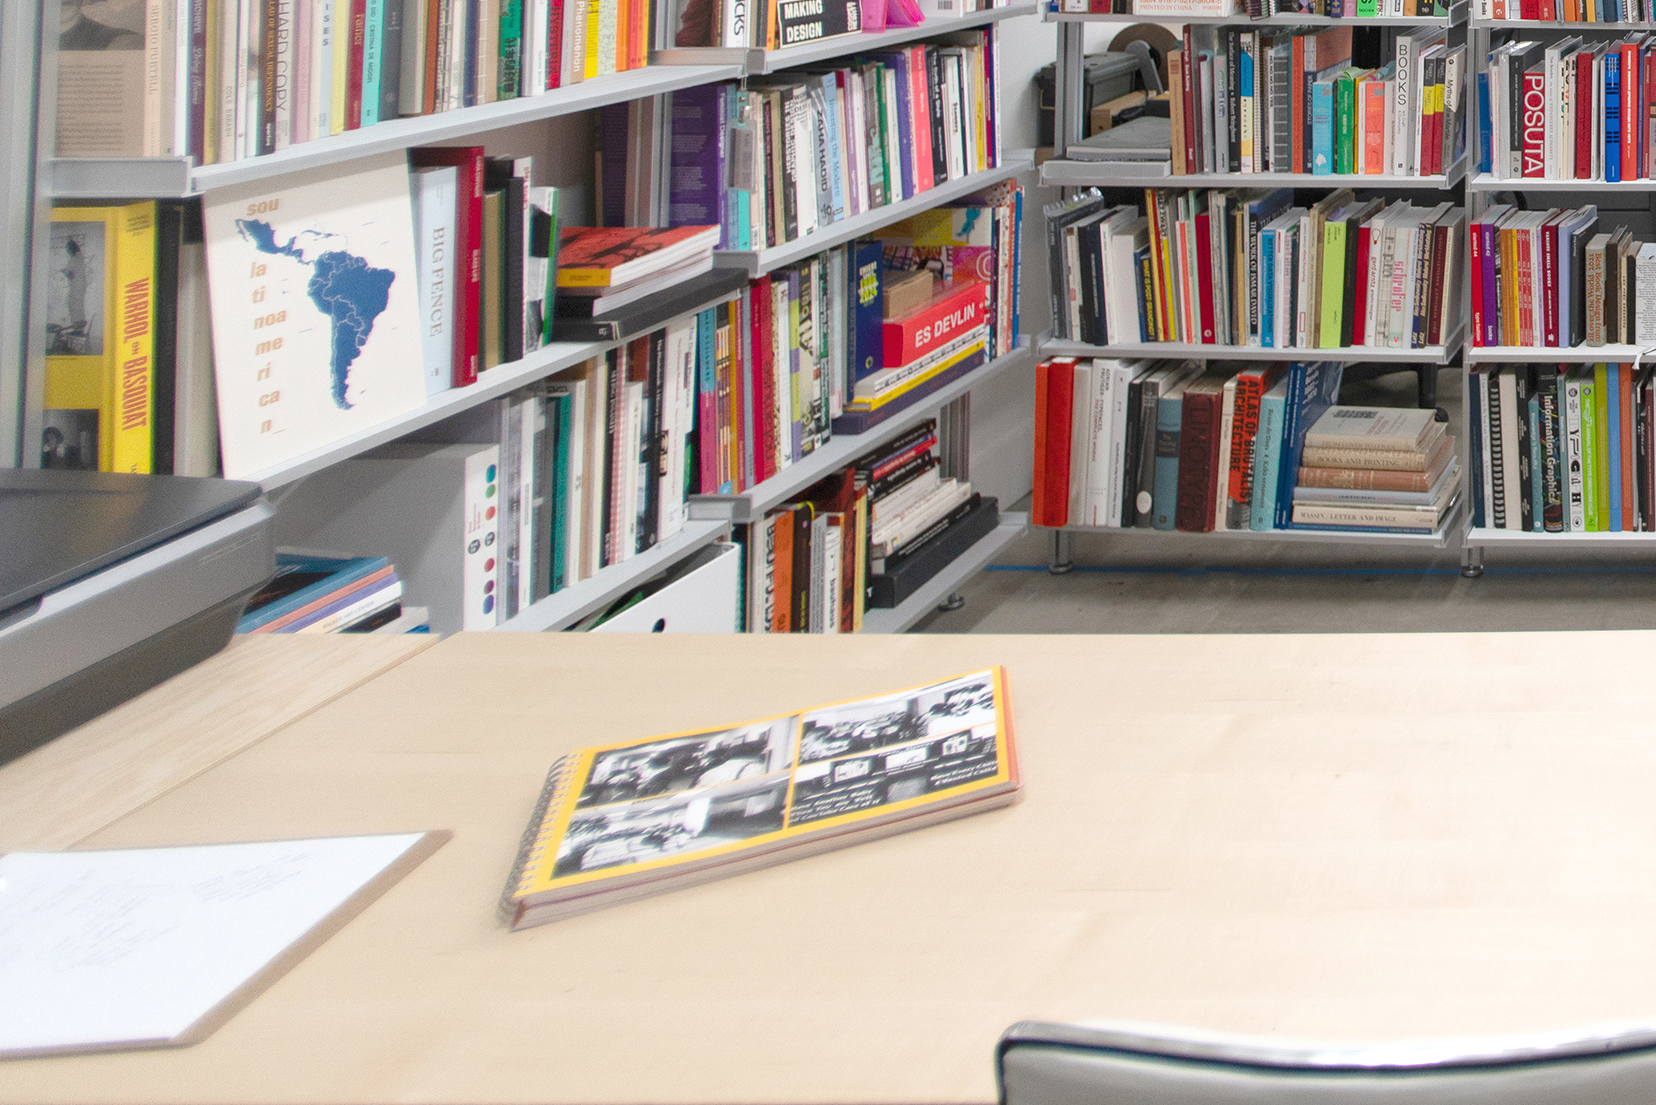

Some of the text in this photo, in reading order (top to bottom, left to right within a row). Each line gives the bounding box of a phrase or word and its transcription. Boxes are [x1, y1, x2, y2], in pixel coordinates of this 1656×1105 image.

[784, 0, 822, 19] MAKING
[276, 2, 290, 55] HARD
[573, 0, 586, 73] Phenomenon
[786, 21, 823, 43] DESIGN
[266, 30, 275, 59] SEXUAL
[264, 61, 274, 112] DEPENDENCY
[275, 60, 290, 112] COPY
[1397, 44, 1408, 106] BOOKS
[828, 98, 839, 134] Inventing
[1229, 115, 1237, 143] Bringhurst
[1524, 75, 1545, 174] POSUTA
[816, 110, 828, 192] ZAHA HADID
[831, 153, 841, 197] Modern
[246, 198, 280, 216] sou
[1250, 221, 1258, 235] THE
[250, 262, 267, 279] la
[1250, 261, 1257, 271] OF
[1370, 256, 1378, 270] gerd
[1594, 253, 1602, 269] Best
[252, 285, 267, 303] ti
[430, 227, 445, 337] BIG FENCE
[124, 277, 150, 343] WARHOL
[253, 311, 287, 330] noa
[1250, 295, 1258, 325] DAVID
[1593, 294, 1602, 321] Design
[915, 302, 975, 348] ES DEVLIN
[1594, 323, 1602, 342] from
[255, 337, 284, 356] me
[257, 364, 271, 381] ri
[122, 355, 148, 431] BASQUIAT
[258, 390, 281, 407] ca
[1245, 380, 1260, 419] ATLAS
[1229, 380, 1246, 472] ARCHITECTURE
[1243, 422, 1257, 438] OF
[1317, 456, 1344, 465] BOOKS
[1363, 458, 1400, 467] PRINTING
[1544, 395, 1558, 503] Information Graphics
[1375, 514, 1397, 522] IMAGE
